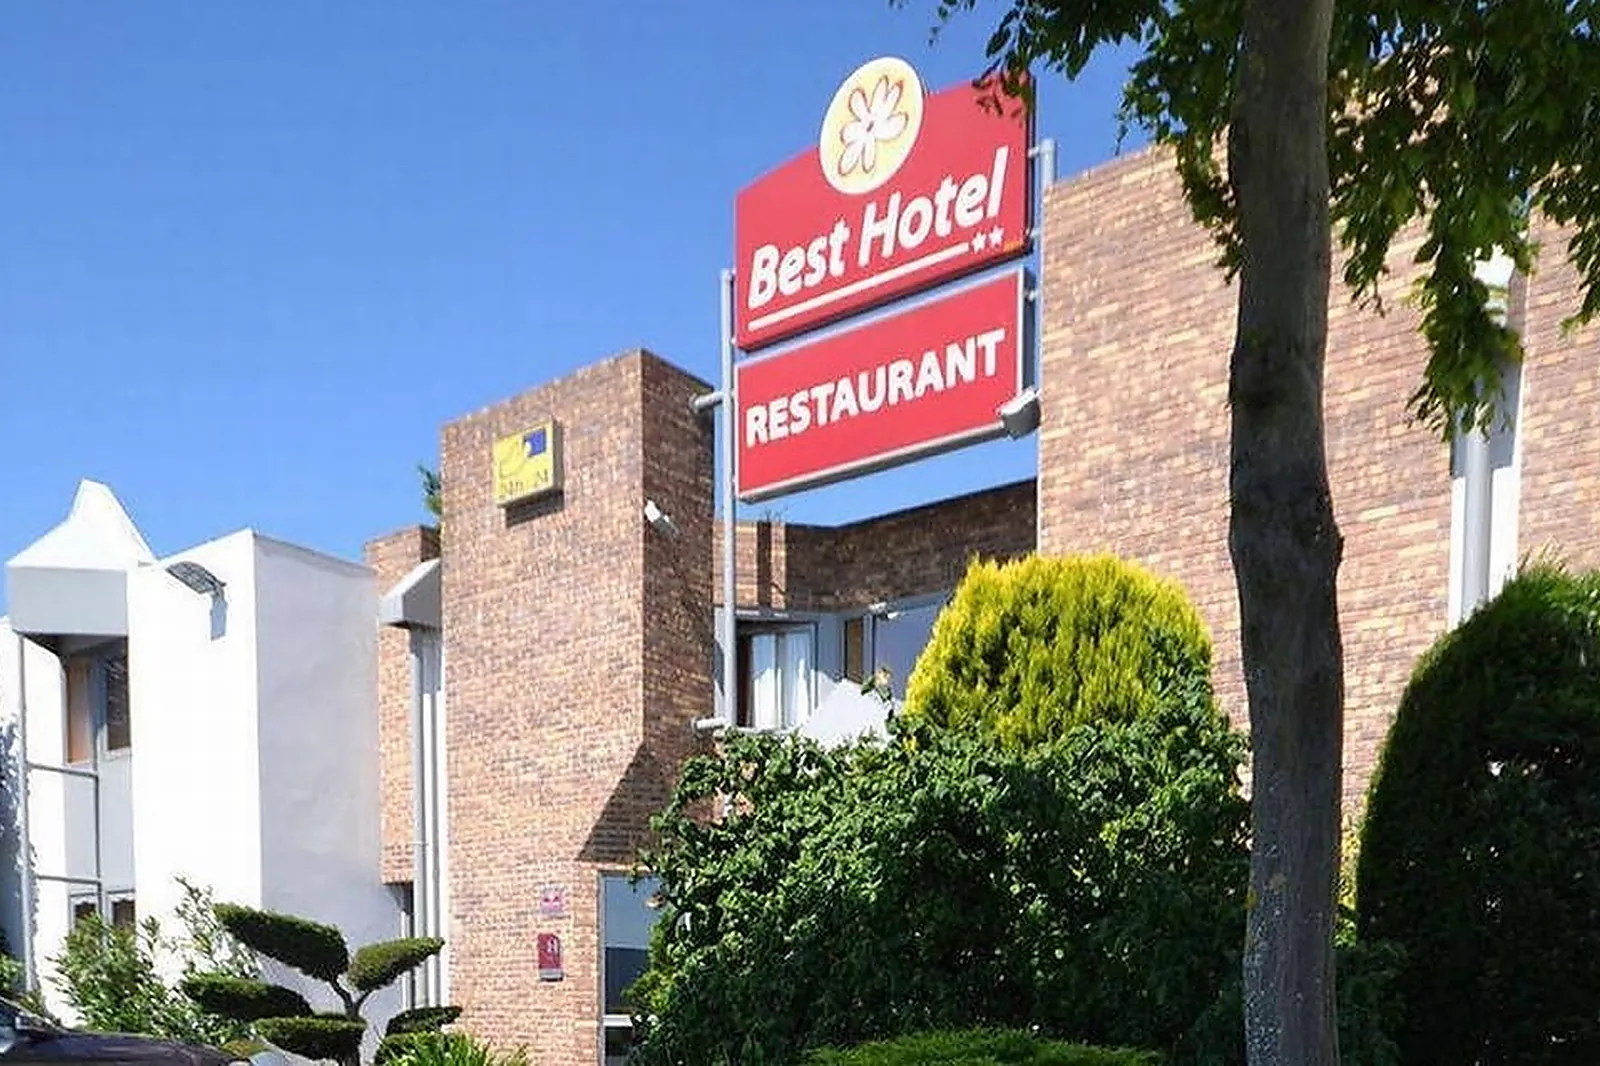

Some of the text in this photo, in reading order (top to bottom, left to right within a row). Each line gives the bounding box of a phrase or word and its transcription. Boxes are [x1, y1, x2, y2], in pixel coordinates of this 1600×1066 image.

[748, 146, 1009, 309] Best Hotel
[745, 328, 1005, 448] RESTAURANT
